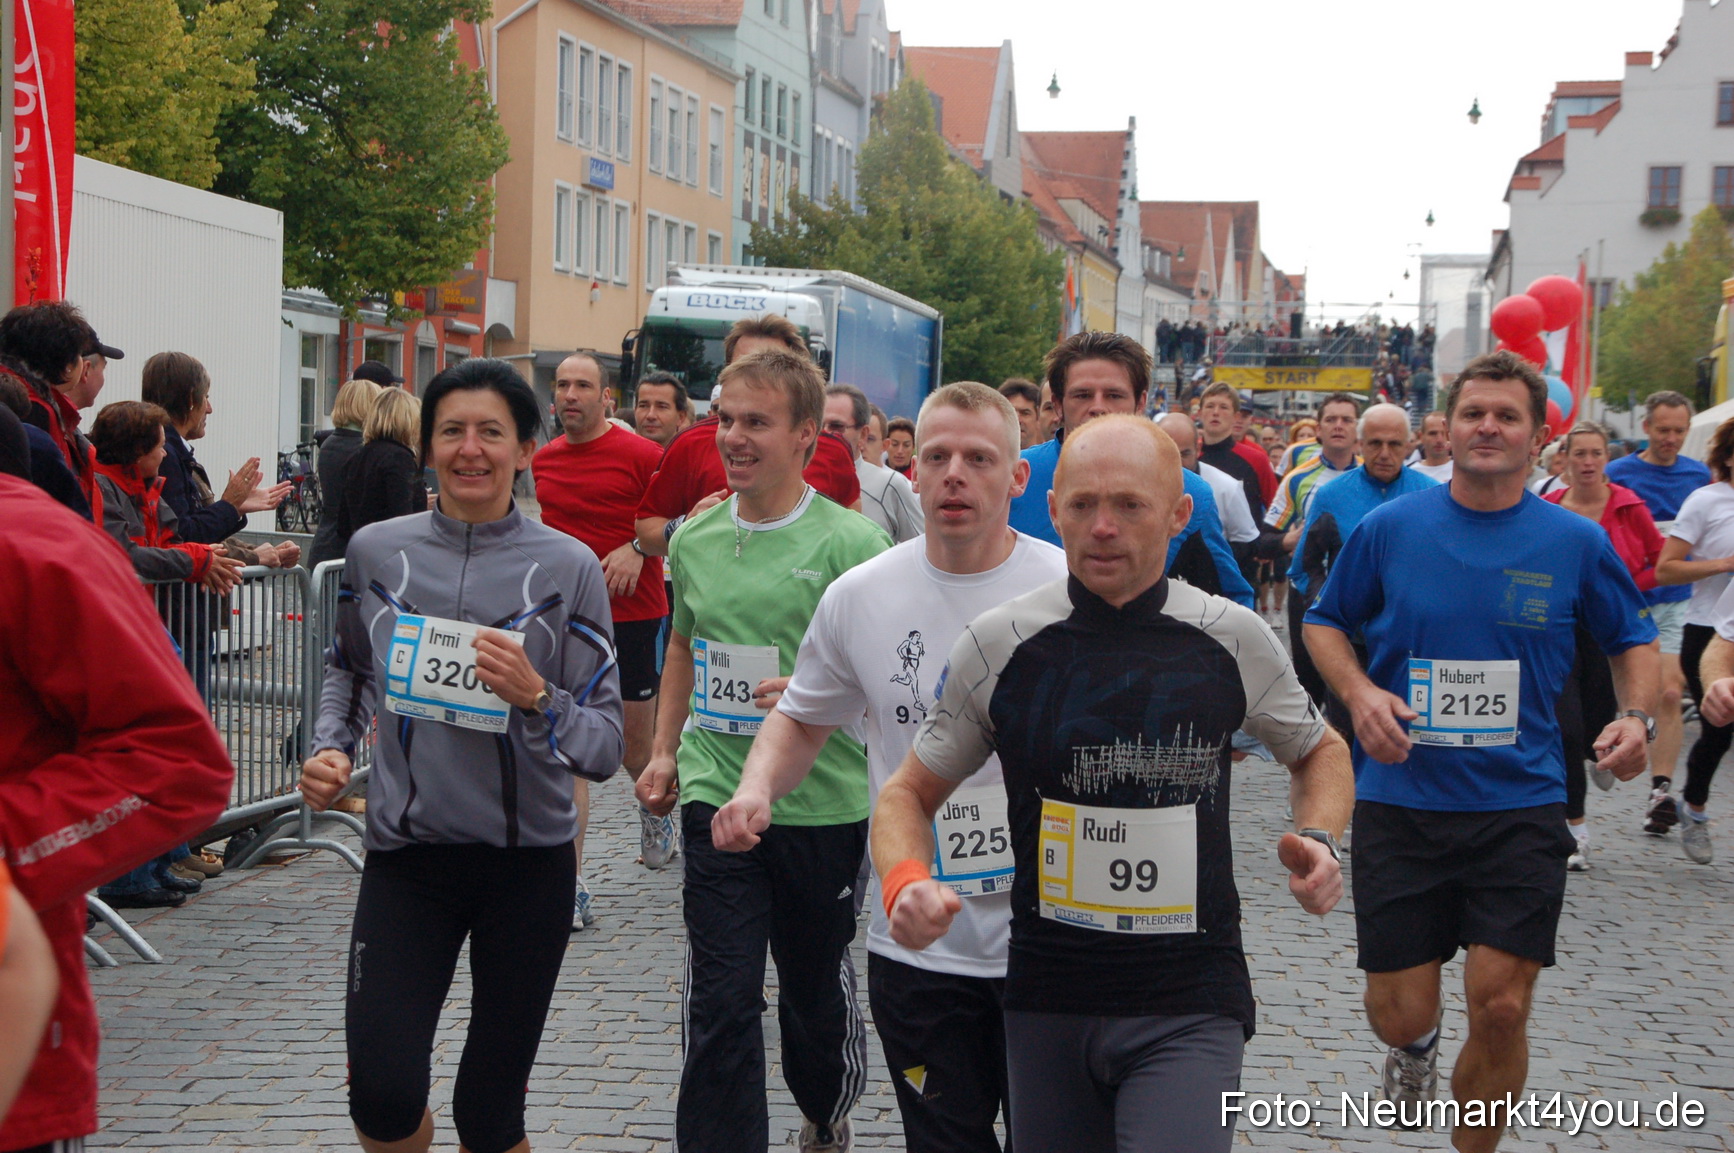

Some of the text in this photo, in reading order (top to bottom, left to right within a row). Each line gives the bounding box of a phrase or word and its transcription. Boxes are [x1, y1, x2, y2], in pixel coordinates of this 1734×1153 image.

[687, 293, 767, 311] BOCK
[1264, 371, 1319, 385] START
[429, 626, 461, 649] Irmi
[396, 650, 405, 664] C
[710, 649, 730, 669] Willi
[1439, 667, 1486, 685] Hubert
[1416, 690, 1423, 702] C
[1440, 693, 1507, 716] 2125
[457, 711, 506, 727] PFLEIDERER
[942, 801, 981, 822] Jörg
[1082, 817, 1127, 843] Rudi
[1045, 848, 1055, 865] B
[1109, 858, 1159, 892] 99
[1135, 913, 1193, 926] PFLEIDERER
